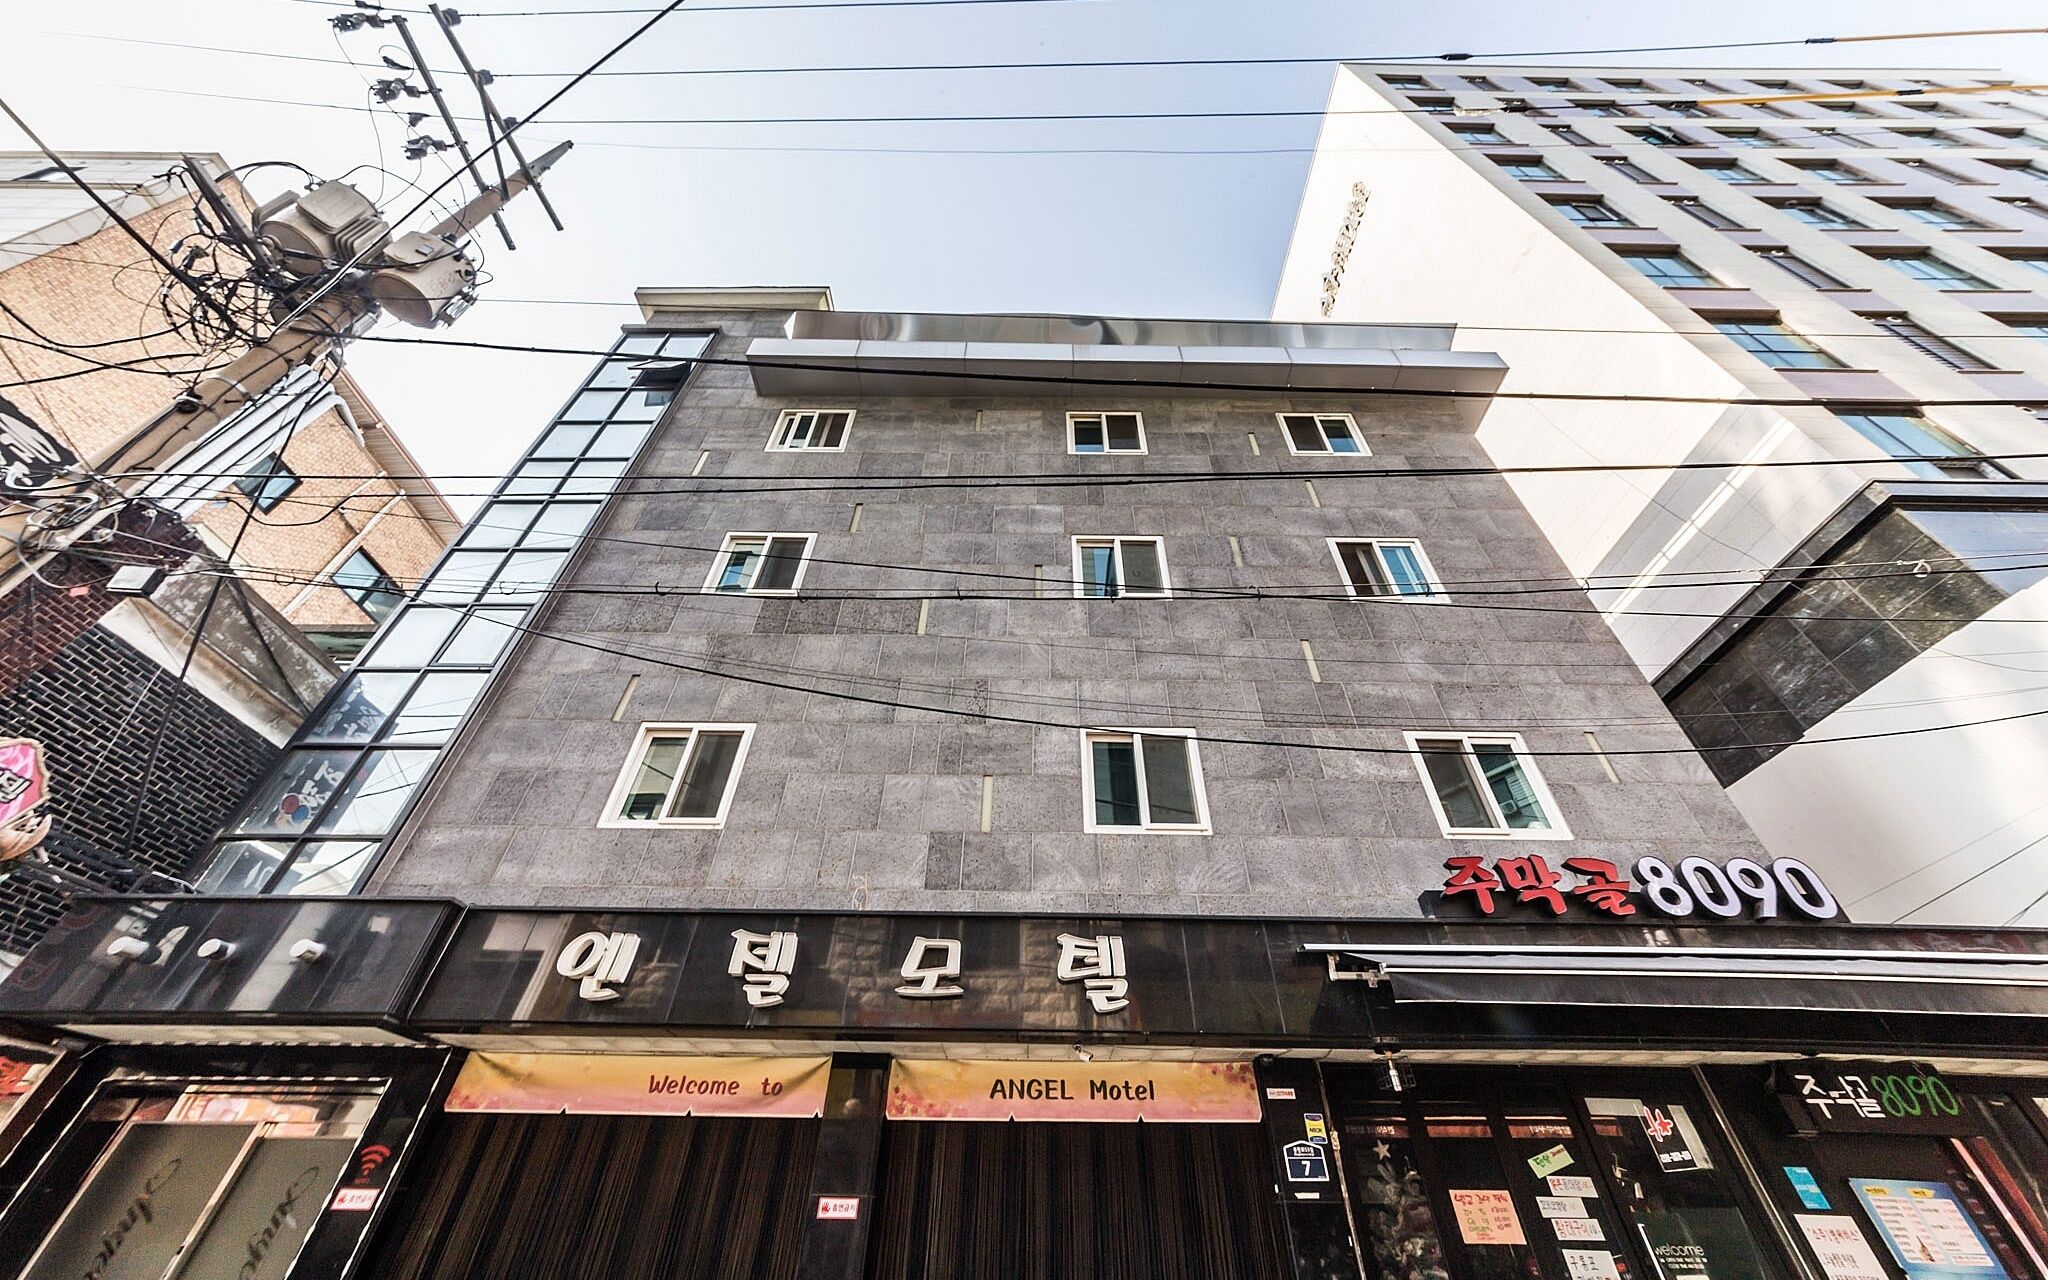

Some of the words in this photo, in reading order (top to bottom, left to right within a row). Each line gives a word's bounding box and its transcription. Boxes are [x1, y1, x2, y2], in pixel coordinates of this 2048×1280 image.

[648, 1074, 739, 1097] Welcome
[761, 1076, 783, 1097] to
[989, 1079, 1074, 1101] ANGEL
[1090, 1079, 1155, 1102] Motel
[1301, 1160, 1311, 1176] 7
[1655, 1244, 1705, 1257] welcome
